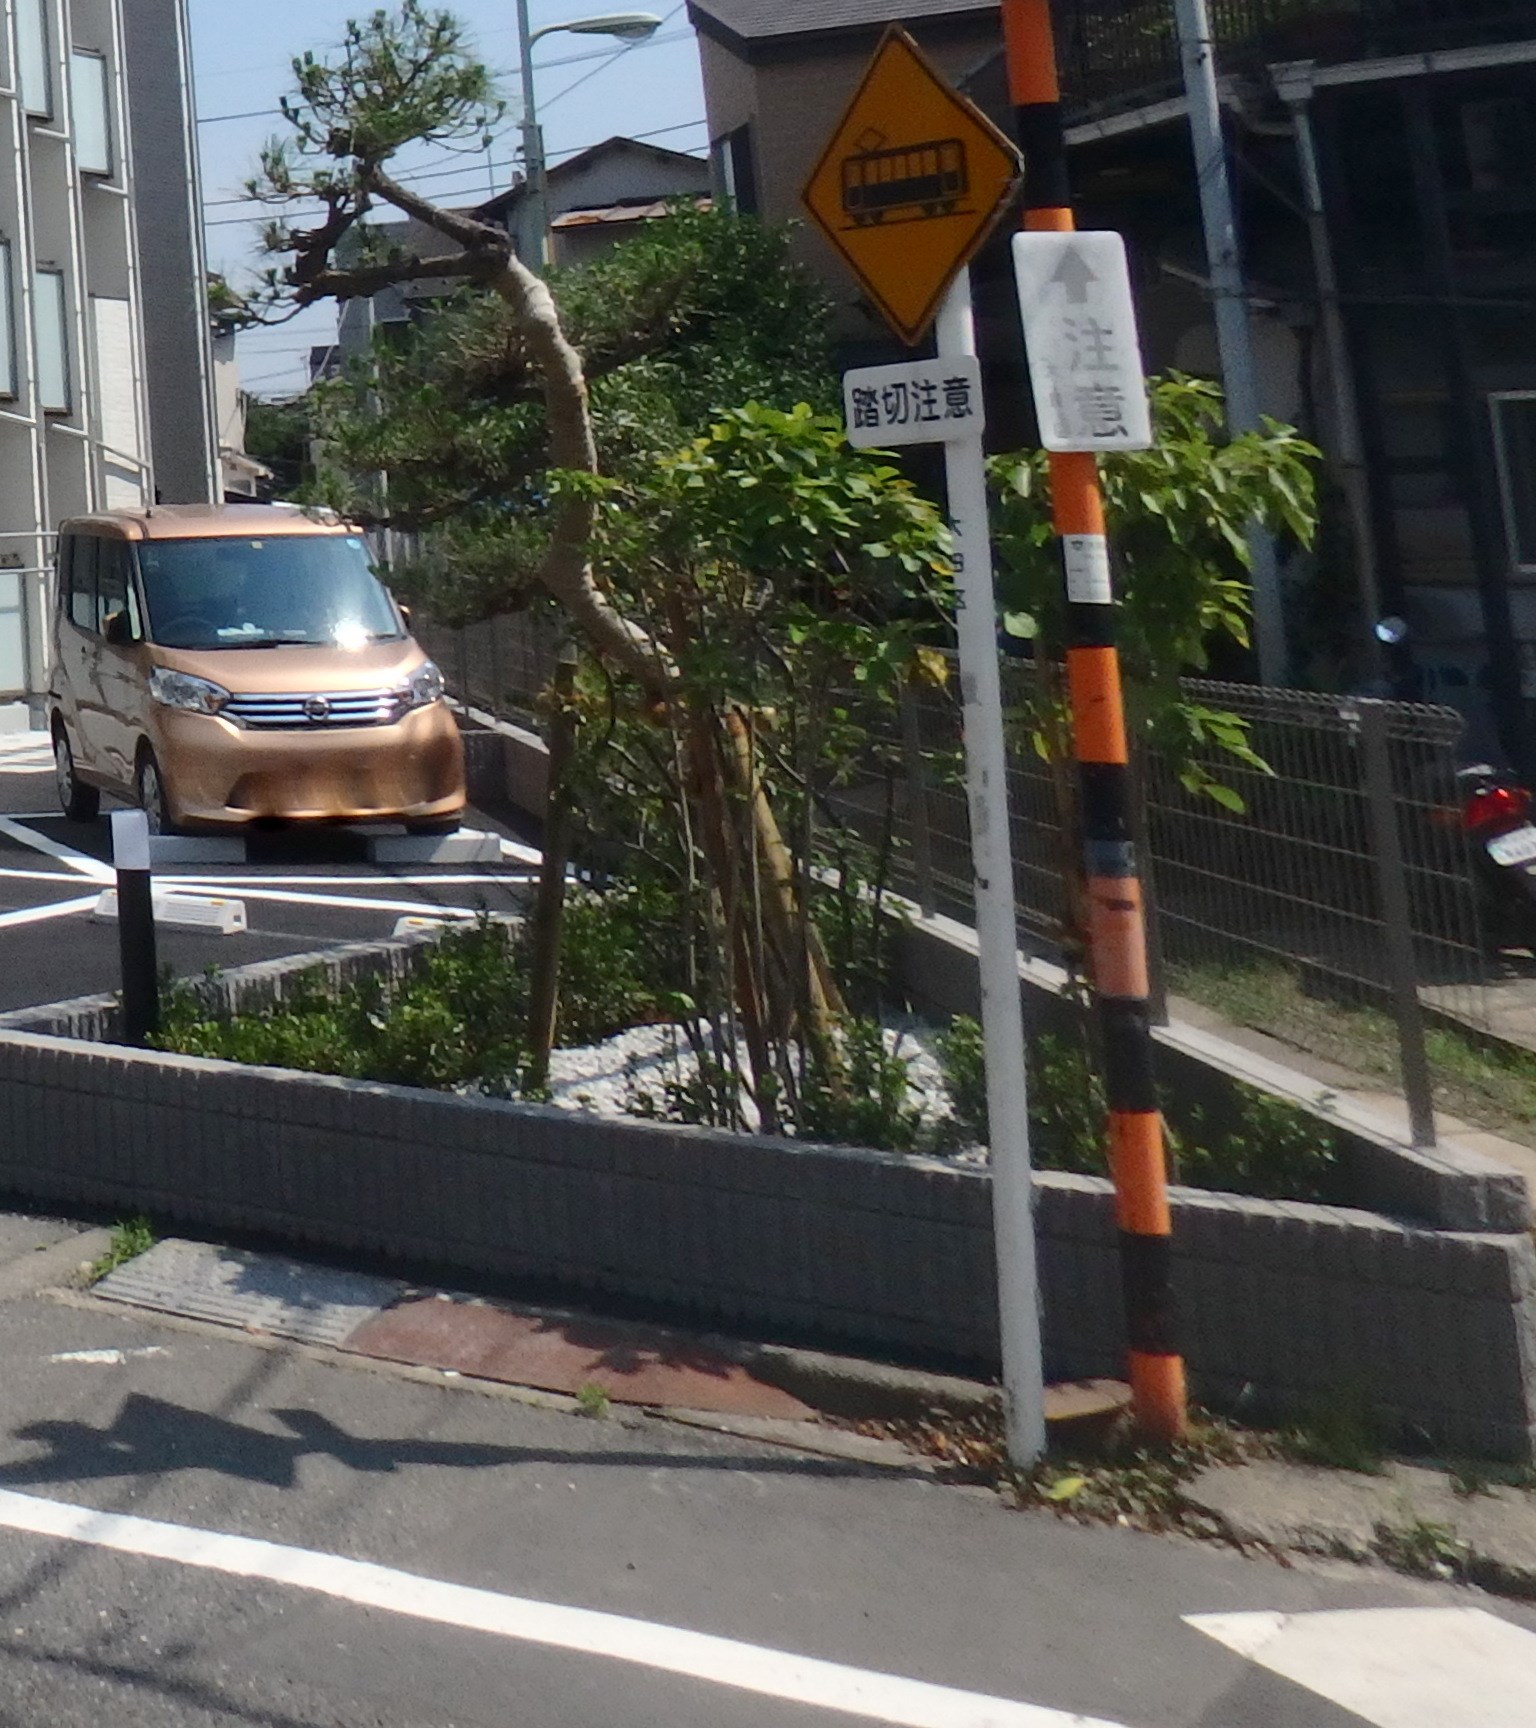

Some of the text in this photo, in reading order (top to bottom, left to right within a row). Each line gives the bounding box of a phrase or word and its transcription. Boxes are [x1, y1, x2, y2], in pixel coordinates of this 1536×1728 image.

[851, 376, 974, 429] 踏切注意
[1061, 316, 1129, 438] 注意
